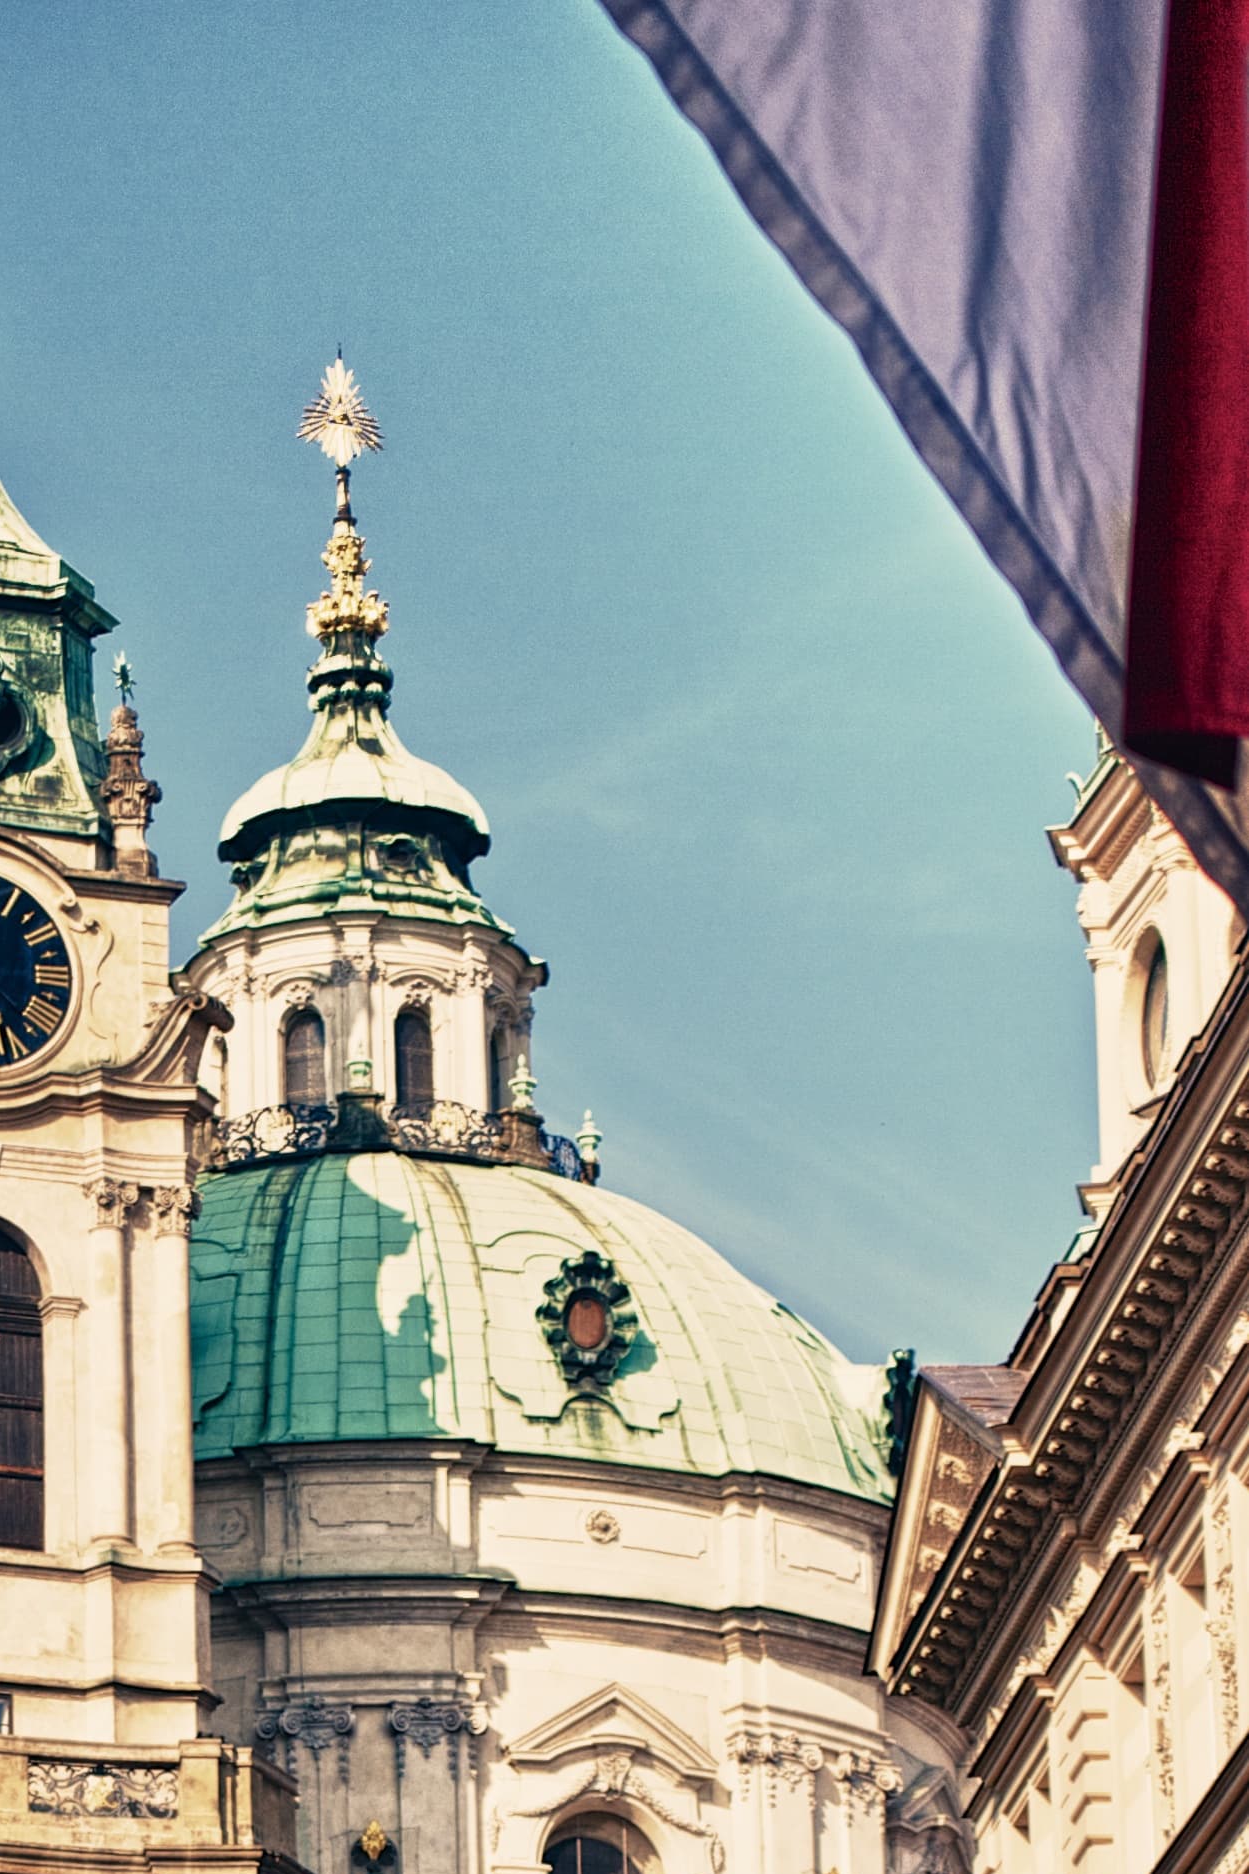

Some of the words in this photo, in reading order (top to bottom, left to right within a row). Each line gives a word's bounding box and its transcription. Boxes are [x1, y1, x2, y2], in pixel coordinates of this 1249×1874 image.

[0, 887, 22, 917] I
[23, 922, 59, 947] II
[34, 964, 69, 989] III
